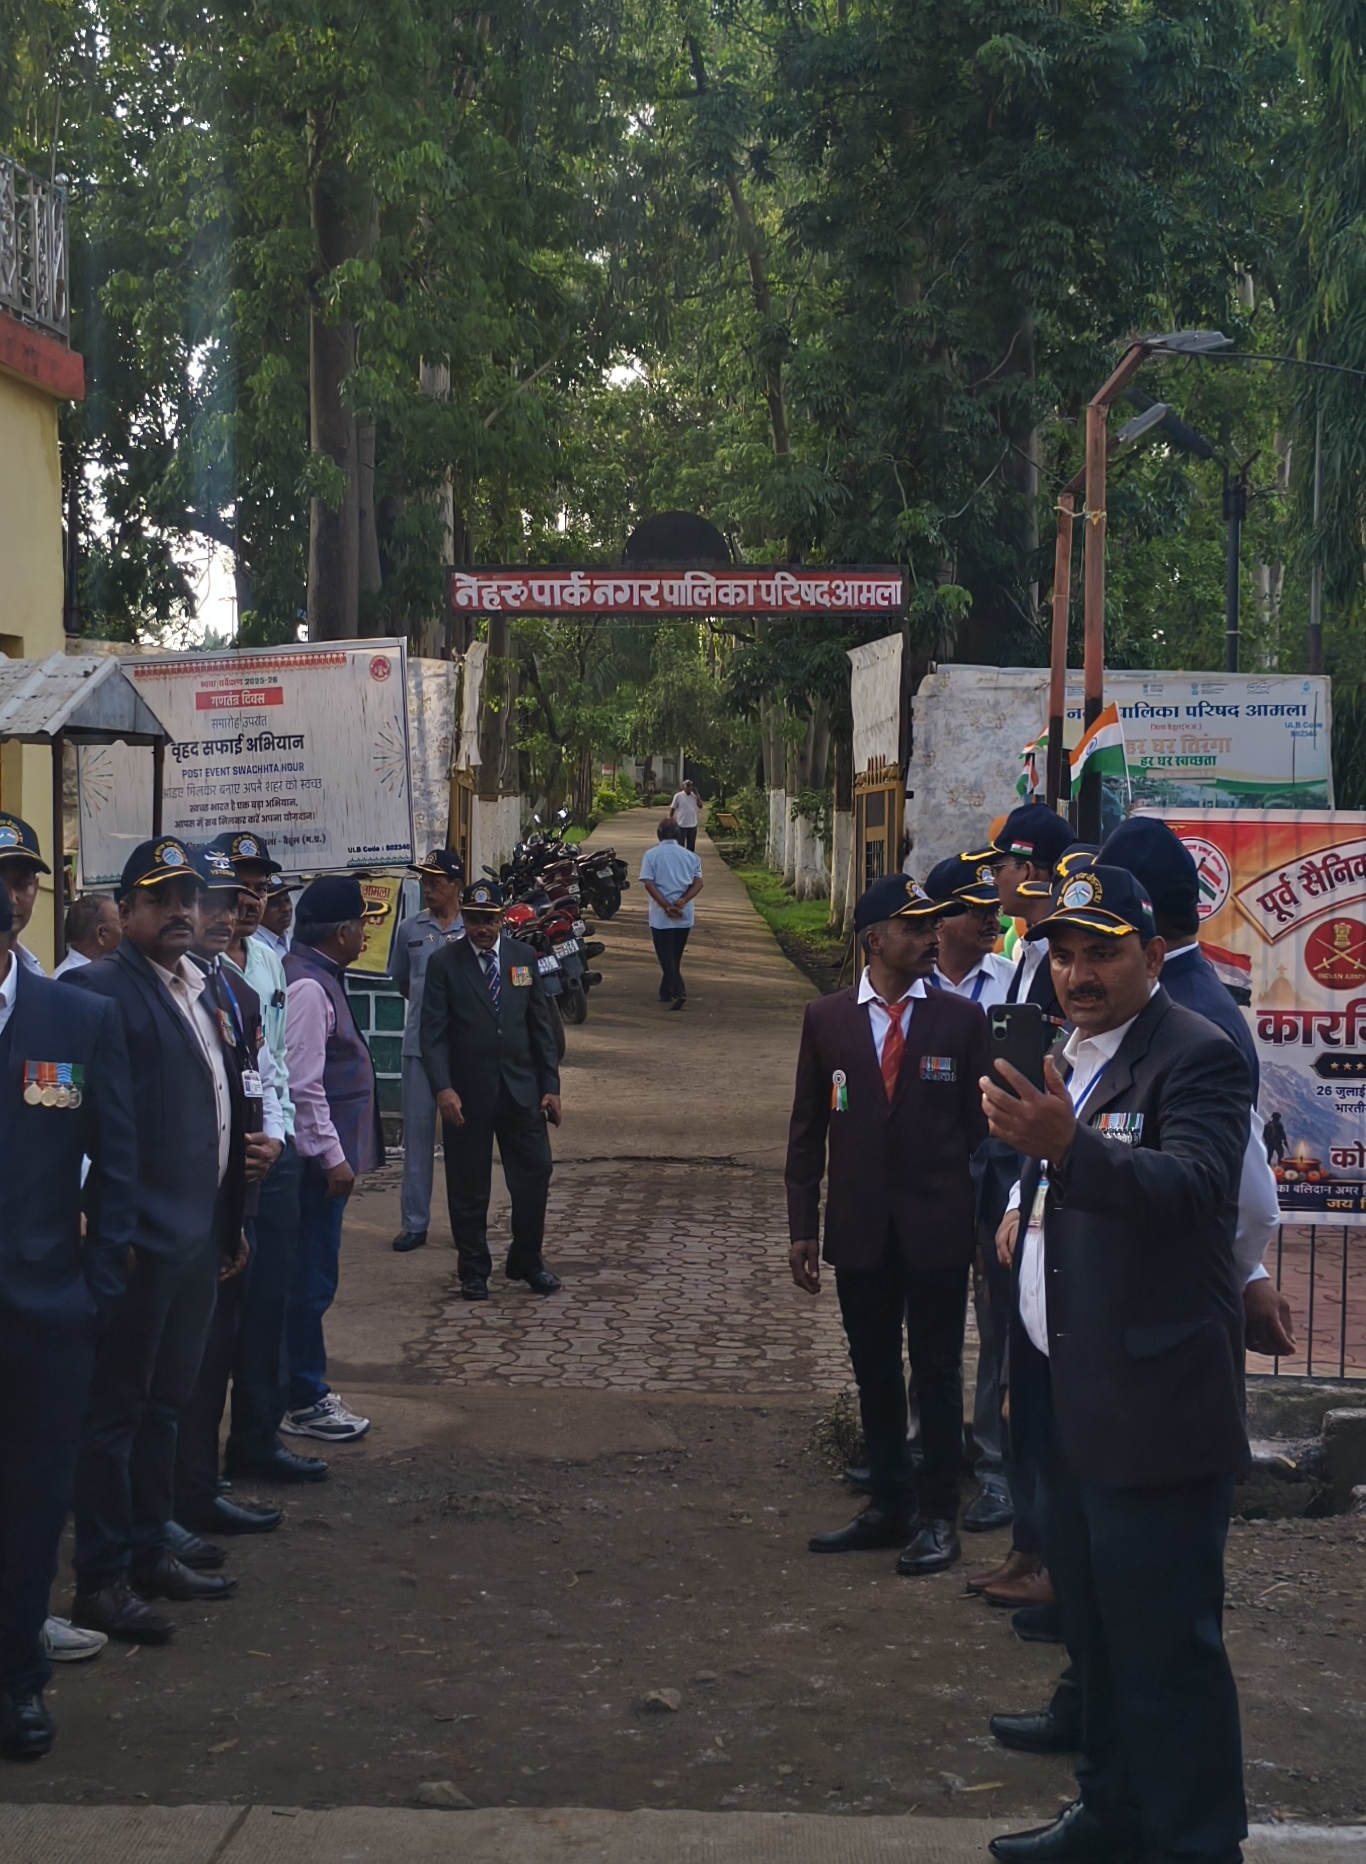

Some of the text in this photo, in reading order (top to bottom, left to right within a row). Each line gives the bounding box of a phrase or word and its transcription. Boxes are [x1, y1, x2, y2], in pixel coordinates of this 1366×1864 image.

[529, 571, 590, 607] पार्क
[593, 579, 660, 607] नगर
[661, 571, 757, 606] पालिका
[759, 571, 831, 607] परिषद
[831, 580, 902, 606] आमला
[211, 689, 266, 707] गणतंत्र दिवस
[1186, 700, 1307, 717] परिषद आमला
[171, 731, 305, 763] वृहद सफाई अभियान
[1151, 739, 1176, 754] घर
[1181, 733, 1232, 754] तिरंगा
[1140, 755, 1217, 767] हर घर स्वच्छता
[182, 762, 304, 779] POST EVENT SWACHHTA HOUR
[187, 783, 217, 797] मिलकर
[265, 780, 283, 793] शहर
[286, 777, 297, 790] को
[1256, 873, 1300, 923] पूर्व
[1316, 1086, 1332, 1096] 26
[1335, 1084, 1366, 1099] जुलाई
[1293, 1182, 1331, 1194] बलिदान
[1335, 1185, 1359, 1195] अमर
[1326, 1199, 1354, 1209] जय
